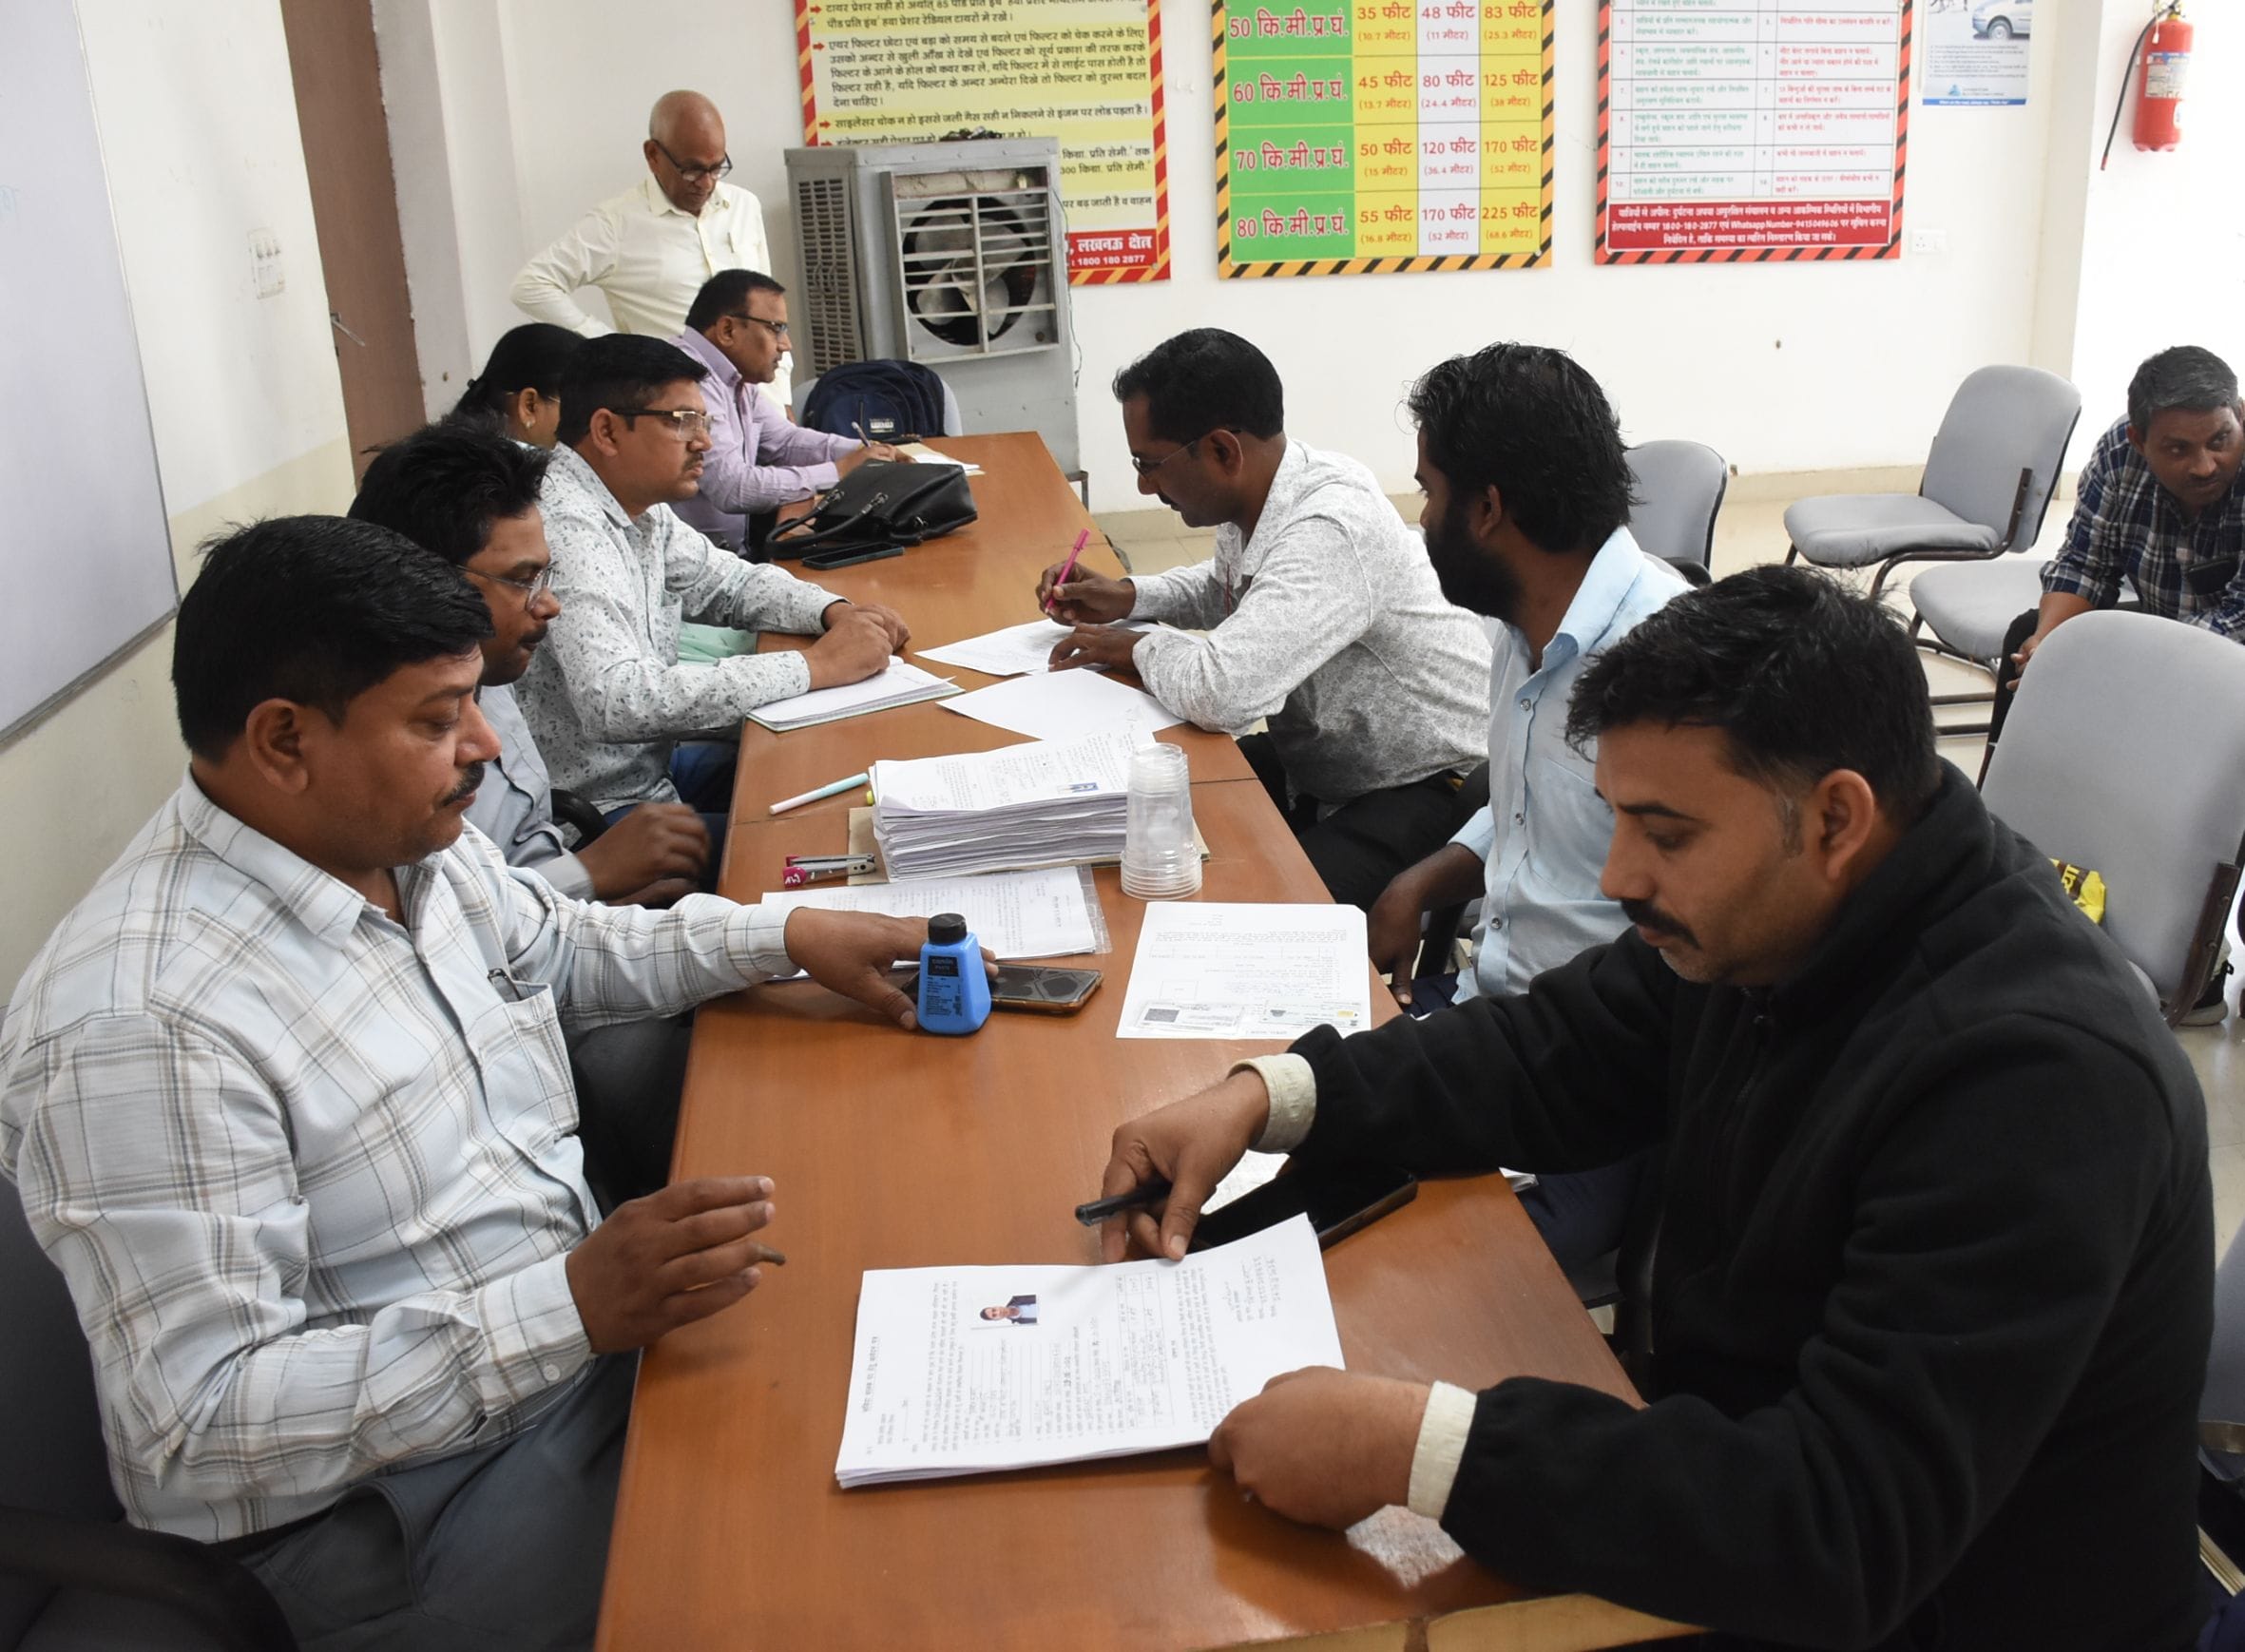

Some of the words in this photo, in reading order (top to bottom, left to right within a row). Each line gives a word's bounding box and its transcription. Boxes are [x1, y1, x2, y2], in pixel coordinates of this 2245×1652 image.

[1357, 7, 1376, 20] 35
[1382, 2, 1411, 20] फीट
[1422, 7, 1441, 19] 48
[1446, 1, 1475, 20] फीट
[1485, 7, 1503, 19] 83
[1508, 1, 1537, 19] फीट
[1229, 17, 1251, 38] 50
[829, 41, 849, 50] एयर
[852, 37, 880, 48] फिल्टर
[883, 36, 903, 47] छोटा
[939, 33, 950, 44] को
[980, 33, 988, 43] से
[1029, 30, 1058, 41] फिल्टर
[1061, 29, 1071, 40] को
[1074, 29, 1090, 39] चेक
[1092, 28, 1113, 38] करने
[1116, 27, 1124, 37] के
[1127, 27, 1144, 38] लिए
[830, 52, 855, 64] उसको
[859, 53, 883, 62] अन्दर
[887, 50, 894, 61] से
[898, 49, 919, 64] खुली
[947, 47, 954, 58] से
[992, 46, 1021, 57] फिल्टर
[1024, 45, 1035, 55] को
[1057, 46, 1083, 54] प्रकाश
[1085, 42, 1096, 53] की
[1099, 45, 1121, 53] तरफ
[1123, 40, 1145, 51] करके
[831, 67, 859, 78] फिल्टर
[862, 66, 871, 76] के
[895, 65, 904, 75] के
[906, 64, 923, 75] होल
[925, 63, 936, 73] को
[992, 60, 1008, 70] यदि
[1010, 59, 1038, 70] फिल्टर
[1052, 58, 1060, 68] से
[1087, 59, 1104, 67] पास
[1107, 56, 1125, 67] होती
[1128, 55, 1134, 67] है
[1136, 55, 1145, 66] तो
[832, 81, 861, 92] फिल्टर
[864, 80, 882, 91] सही
[897, 78, 914, 89] यदि
[917, 78, 946, 89] फिल्टर
[950, 76, 958, 86] के
[961, 78, 985, 86] अन्दर
[1042, 73, 1050, 84] तो
[1054, 72, 1082, 83] फिल्टर
[1085, 71, 1096, 82] को
[1125, 72, 1146, 81] बदल
[1358, 76, 1378, 88] 45
[1384, 70, 1412, 88] फीट
[1423, 75, 1440, 87] 80
[1446, 69, 1475, 88] फीट
[1484, 74, 1506, 86] 125
[1512, 68, 1538, 86] फीट
[834, 96, 850, 107] देना
[1234, 82, 1254, 103] 60
[907, 113, 916, 125] हो
[943, 111, 962, 122] जली
[983, 109, 999, 121] सही
[1010, 107, 1045, 119] निकलने
[1047, 107, 1055, 118] से
[1360, 144, 1378, 157] 50
[1383, 138, 1412, 156] फीट
[1423, 142, 1445, 154] 120
[1450, 137, 1476, 154] फीट
[1485, 141, 1507, 153] 170
[1512, 136, 1538, 153] फीट
[1235, 150, 1257, 171] 70
[1360, 211, 1378, 223] 55
[1384, 205, 1413, 222] फीट
[1422, 209, 1445, 221] 170
[1449, 203, 1476, 221] फीट
[1482, 207, 1507, 220] 225
[1512, 202, 1538, 220] फीट
[1237, 218, 1257, 238] 80
[1077, 237, 1123, 253] लखनऊ
